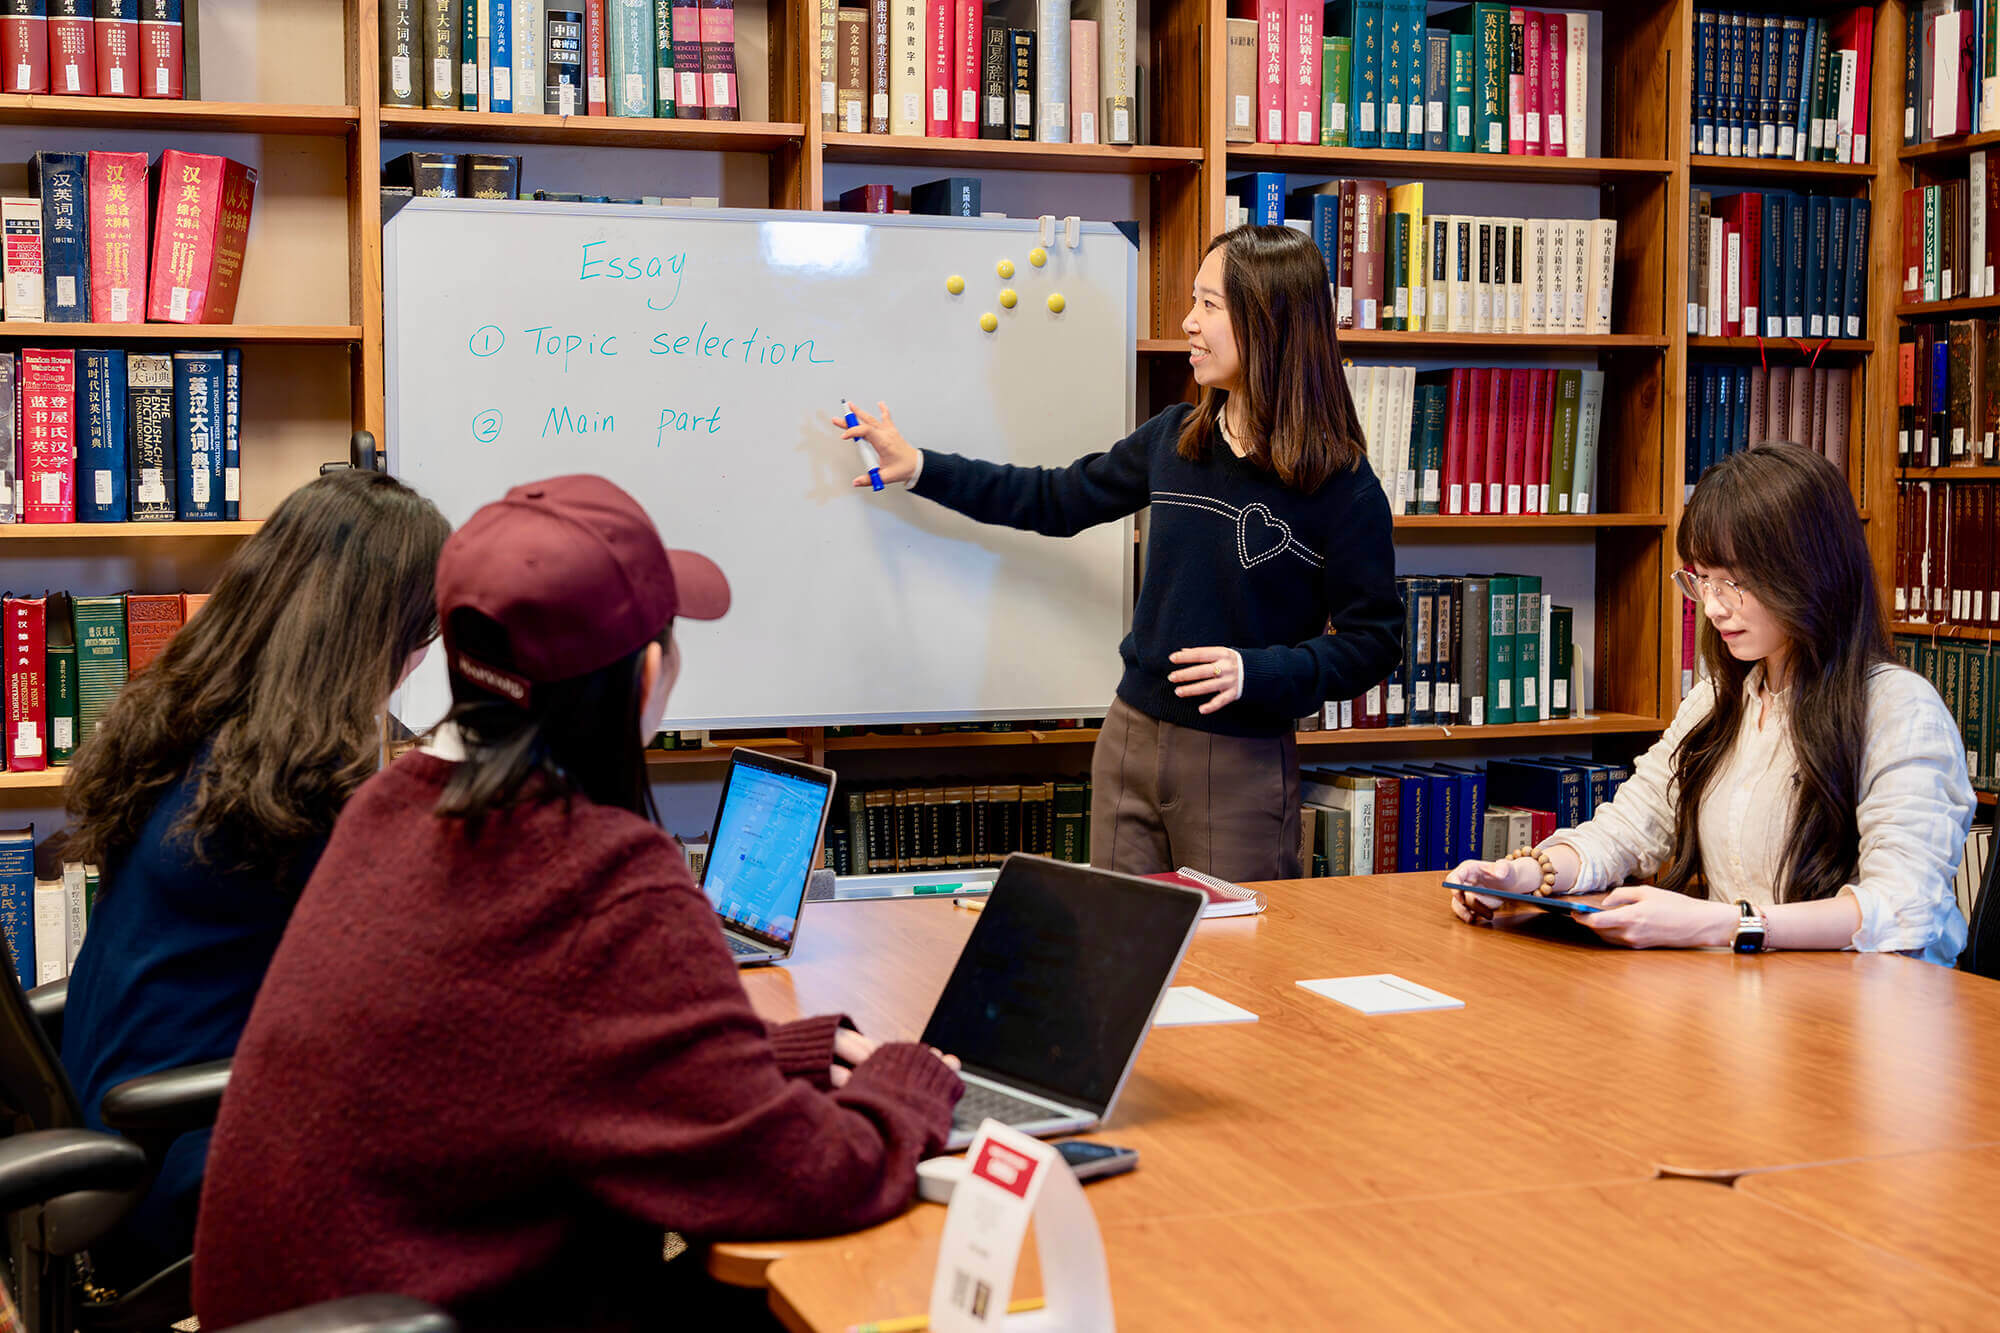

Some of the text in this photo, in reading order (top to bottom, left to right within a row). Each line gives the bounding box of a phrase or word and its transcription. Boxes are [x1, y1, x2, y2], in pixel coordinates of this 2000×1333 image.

[1267, 12, 1280, 84] 中国医籍大辞典
[1299, 13, 1312, 86] 中国医籍大辞典
[1484, 14, 1499, 116] 英汉军事大词典
[52, 174, 74, 230] 汉英词典
[106, 164, 128, 202] 汉英
[180, 166, 202, 204] 汉英
[580, 240, 687, 311] Essay
[131, 359, 169, 371] 英汉
[524, 326, 618, 372] Topic
[649, 321, 835, 365] selection
[132, 372, 170, 383] 大词典
[29, 396, 68, 408] 蓝登
[31, 412, 68, 423] 书屋
[88, 357, 102, 448] 新时代汉英大词典
[161, 396, 170, 418] THE
[31, 426, 68, 438] 韦氏
[142, 396, 153, 464] DICTIONARY
[189, 377, 210, 470] 英汉大词典
[542, 406, 615, 438] Main
[656, 406, 721, 448] part
[30, 441, 68, 453] 英汉
[31, 456, 68, 468] 大学
[1421, 670, 1426, 678] 2
